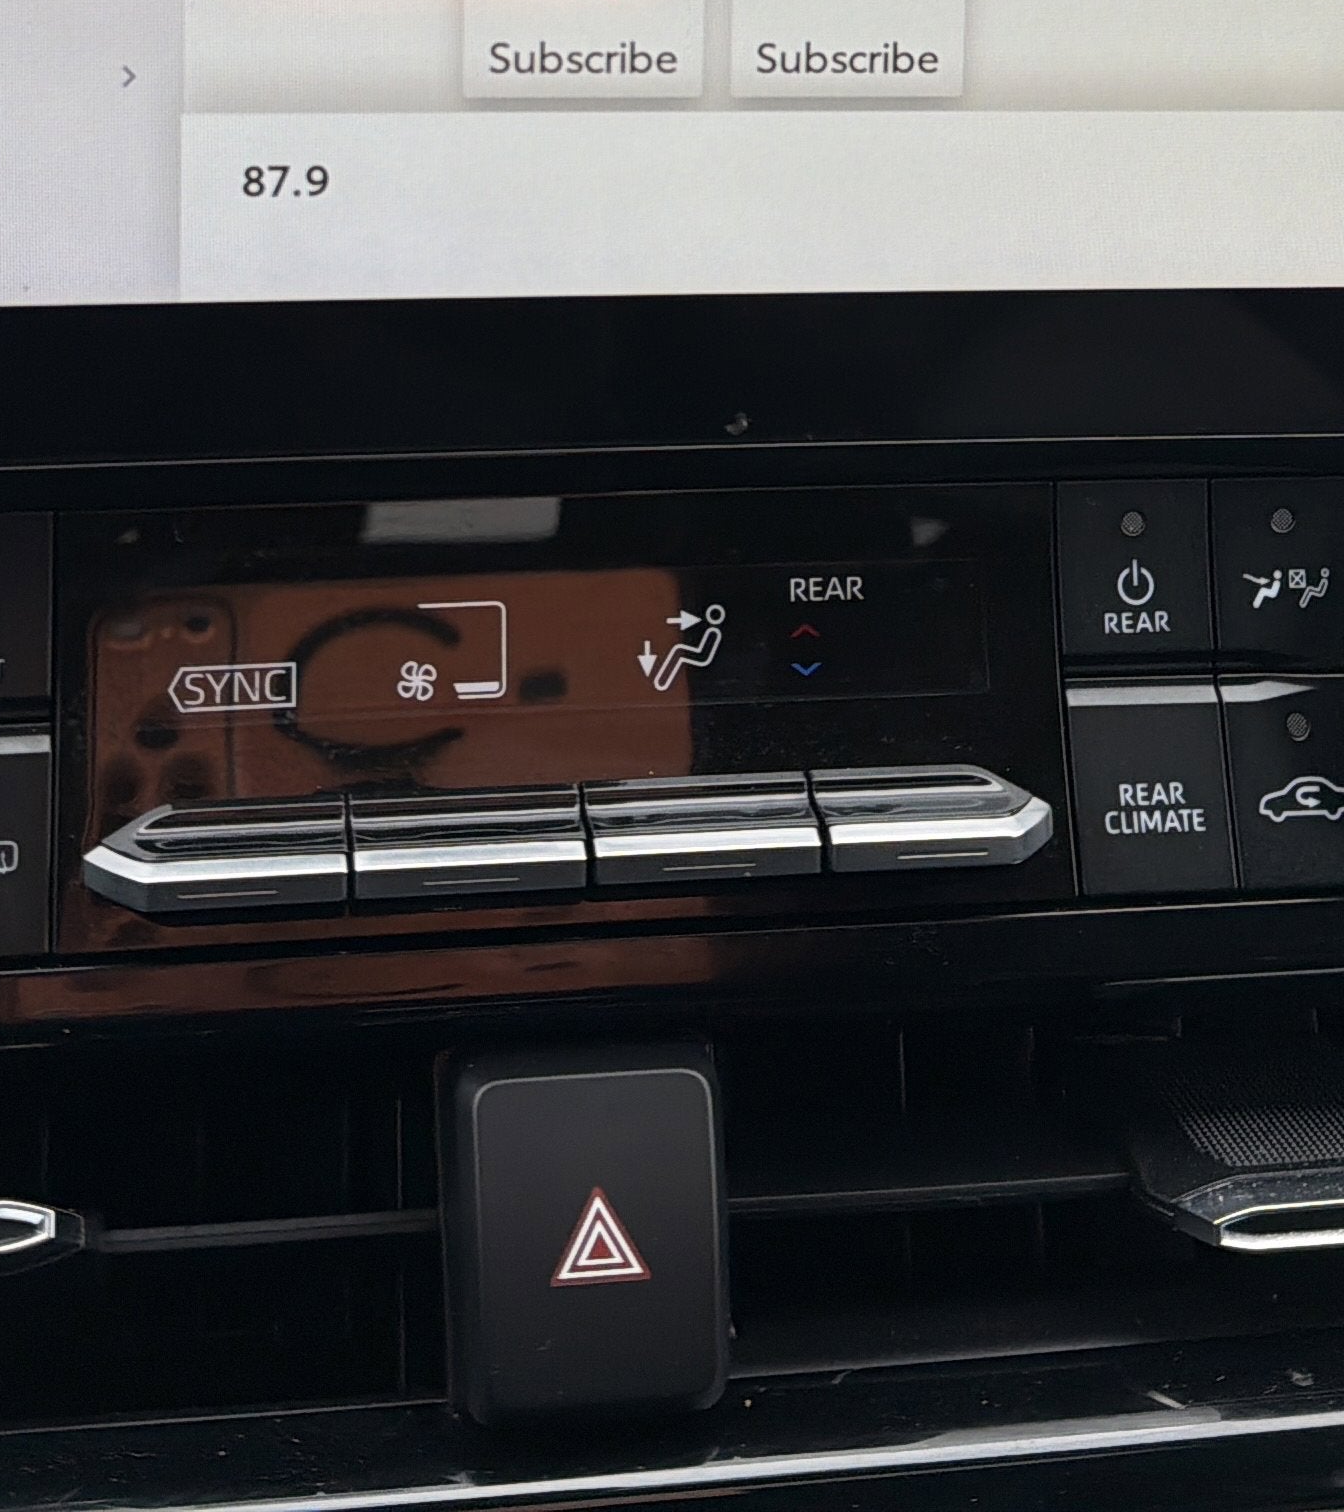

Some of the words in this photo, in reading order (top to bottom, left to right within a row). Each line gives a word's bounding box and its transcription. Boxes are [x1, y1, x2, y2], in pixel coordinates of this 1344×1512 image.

[490, 41, 677, 74] Subscribe
[757, 42, 938, 73] Subscribe
[243, 165, 329, 197] 87.9
[790, 577, 863, 601] REAR
[1104, 611, 1169, 633] REAR
[181, 670, 290, 707] SYNC
[1119, 782, 1185, 806] REAR
[1105, 809, 1205, 834] CLIMATE
